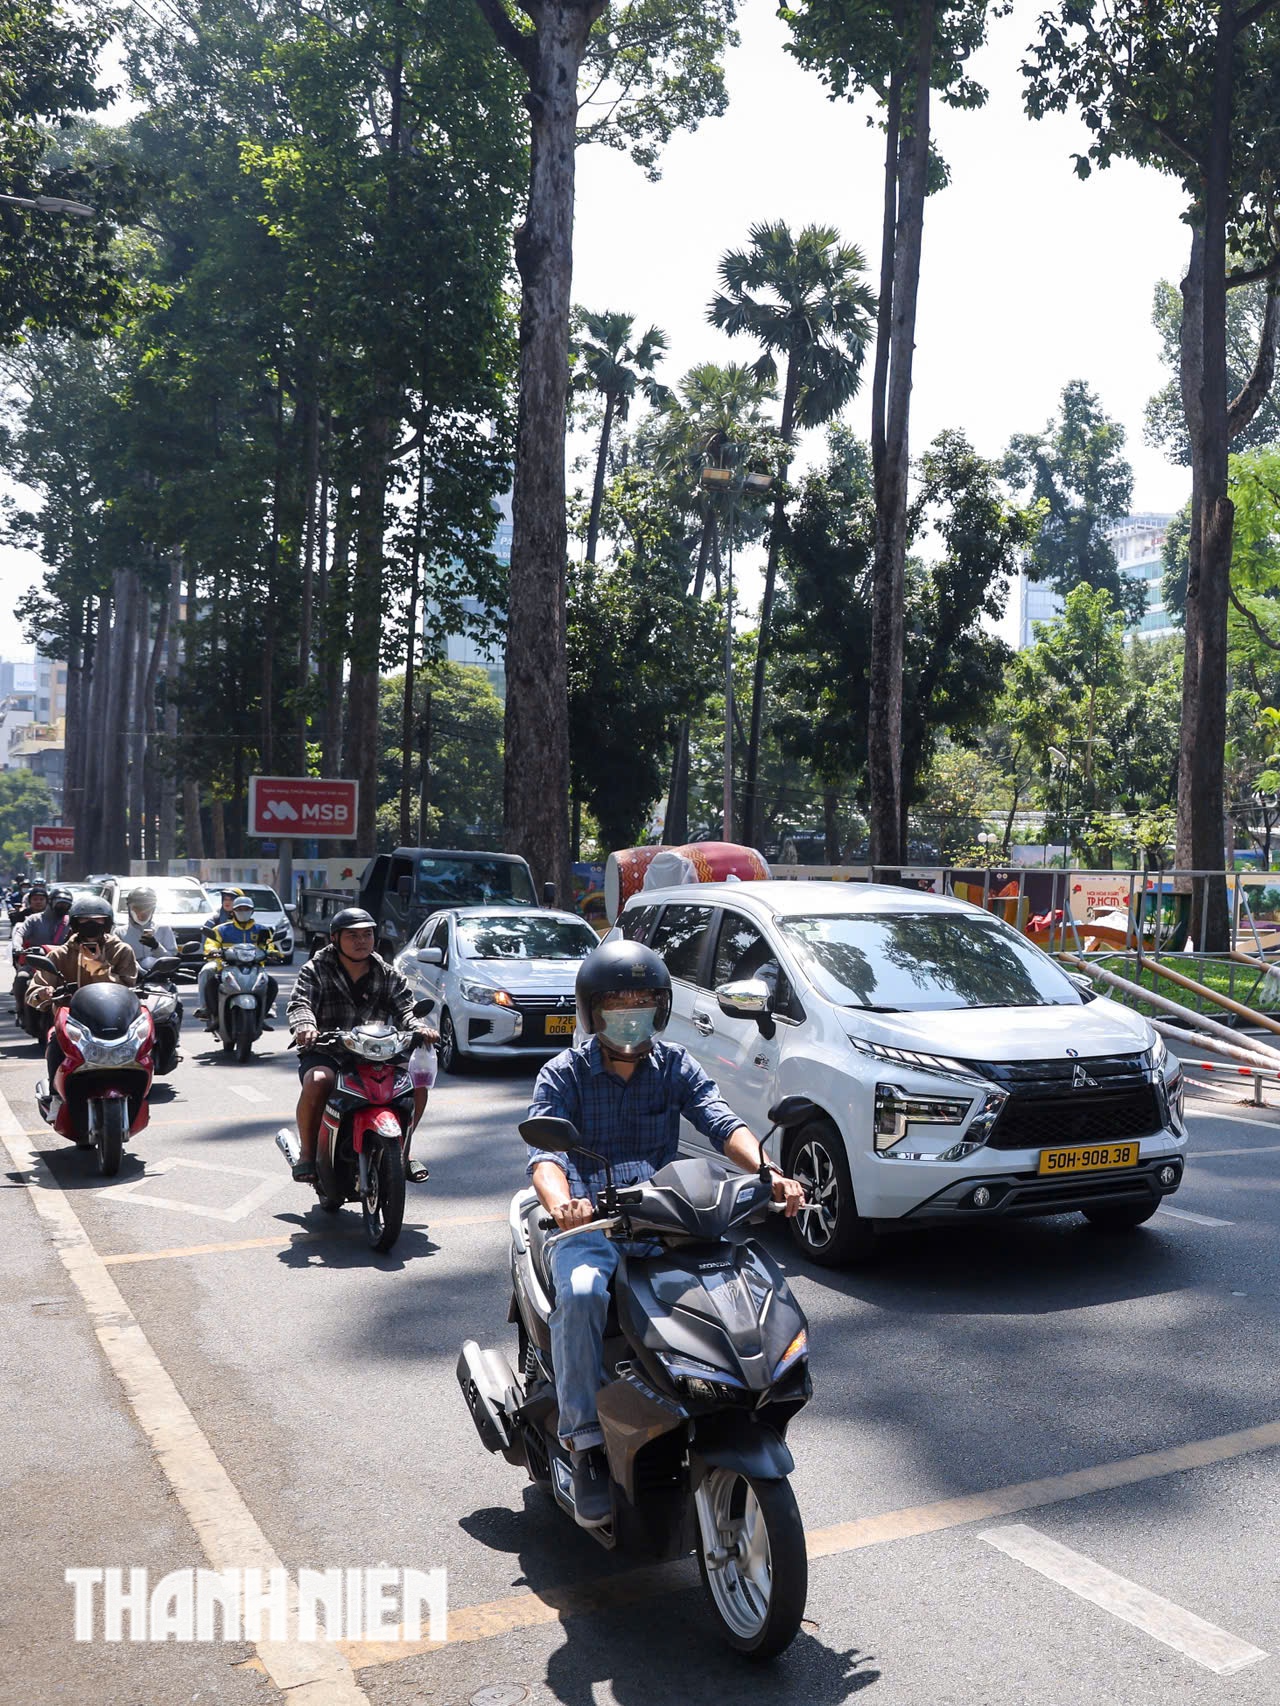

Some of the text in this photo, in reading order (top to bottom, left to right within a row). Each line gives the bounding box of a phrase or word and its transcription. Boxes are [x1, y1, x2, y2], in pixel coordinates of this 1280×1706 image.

[302, 803, 348, 820] MSB
[1087, 897, 1119, 906] TP.HCM
[1047, 1147, 1131, 1169] 50H-908.38
[698, 1261, 732, 1270] HONDA
